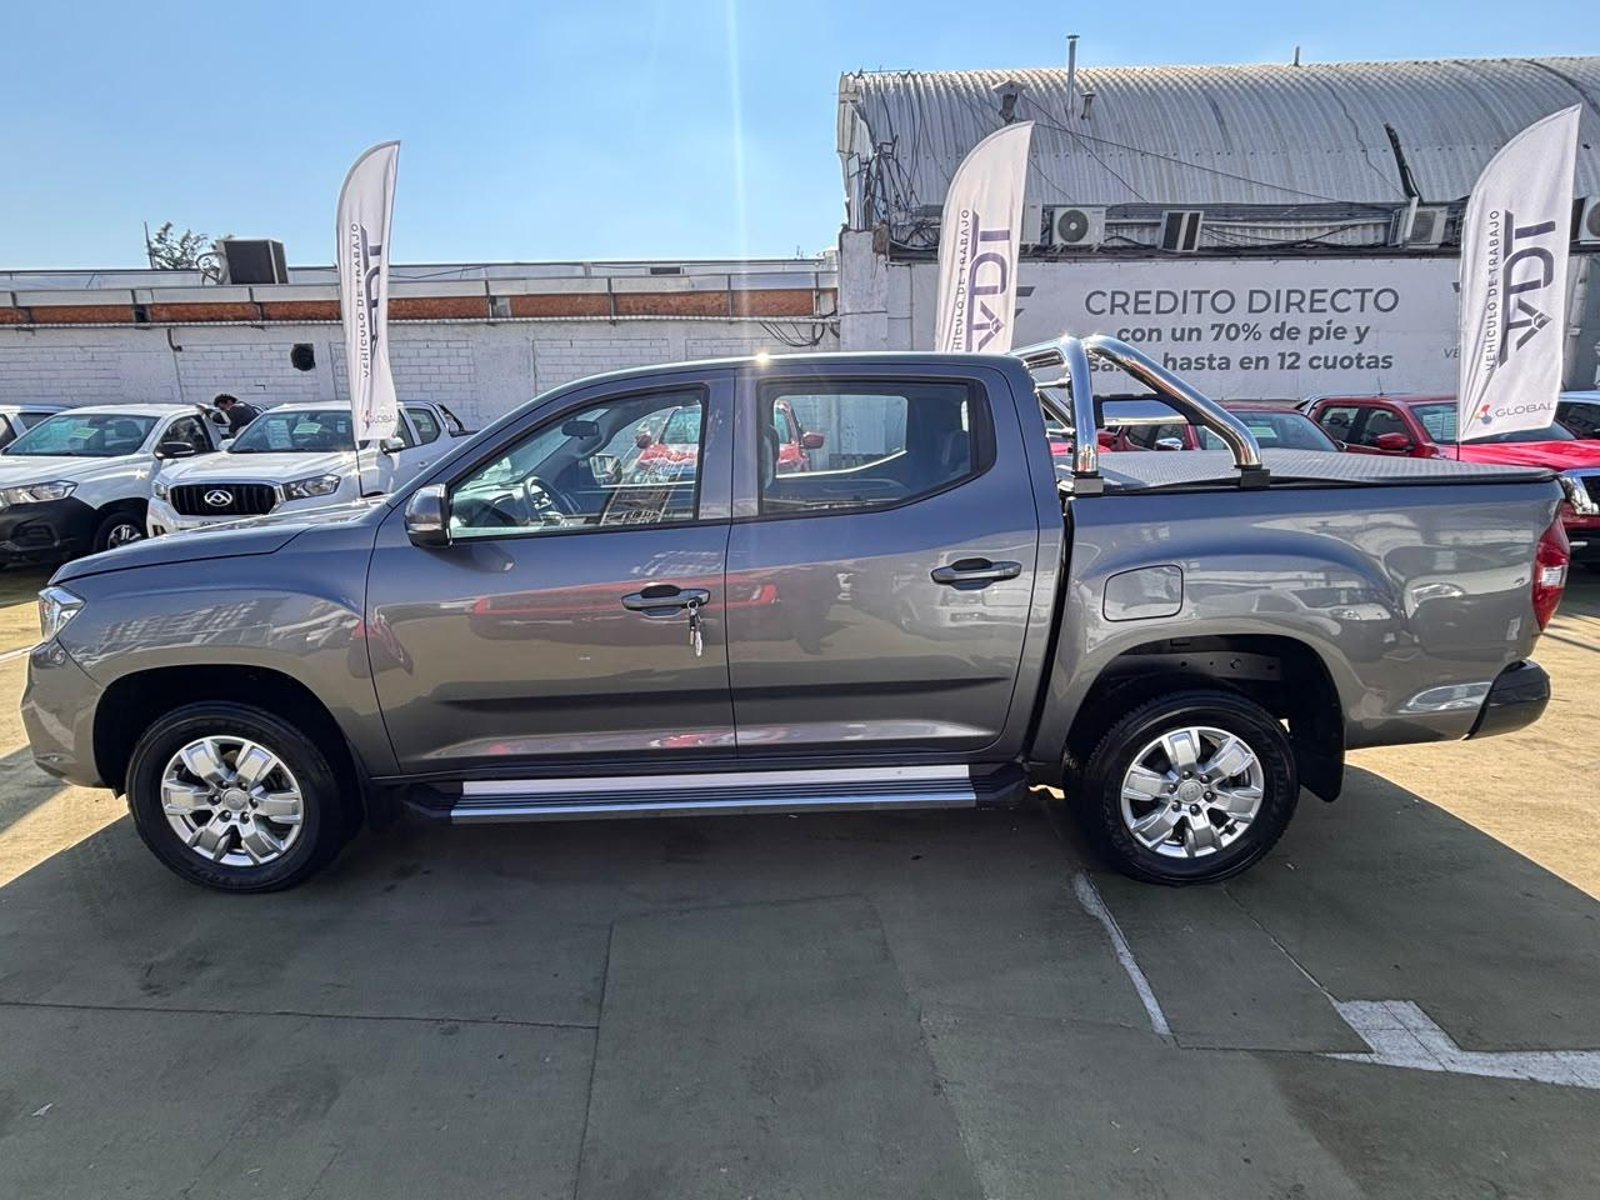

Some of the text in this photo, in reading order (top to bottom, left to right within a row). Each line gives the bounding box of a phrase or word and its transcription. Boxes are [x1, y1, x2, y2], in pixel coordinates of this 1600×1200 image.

[1487, 210, 1500, 276] TRABAJO
[954, 209, 970, 350] HÍCULO DE TRABAJO
[1487, 279, 1498, 296] DE
[356, 290, 365, 307] DE
[1085, 287, 1400, 316] CREDITO DIRECTO
[1117, 327, 1162, 342] con
[1171, 326, 1203, 342] un
[1210, 322, 1262, 342] 70%
[1269, 320, 1301, 341] de
[1353, 325, 1371, 345] y
[1163, 351, 1394, 371] hasta en 12 cuotas
[1495, 402, 1554, 417] GLOBAL
